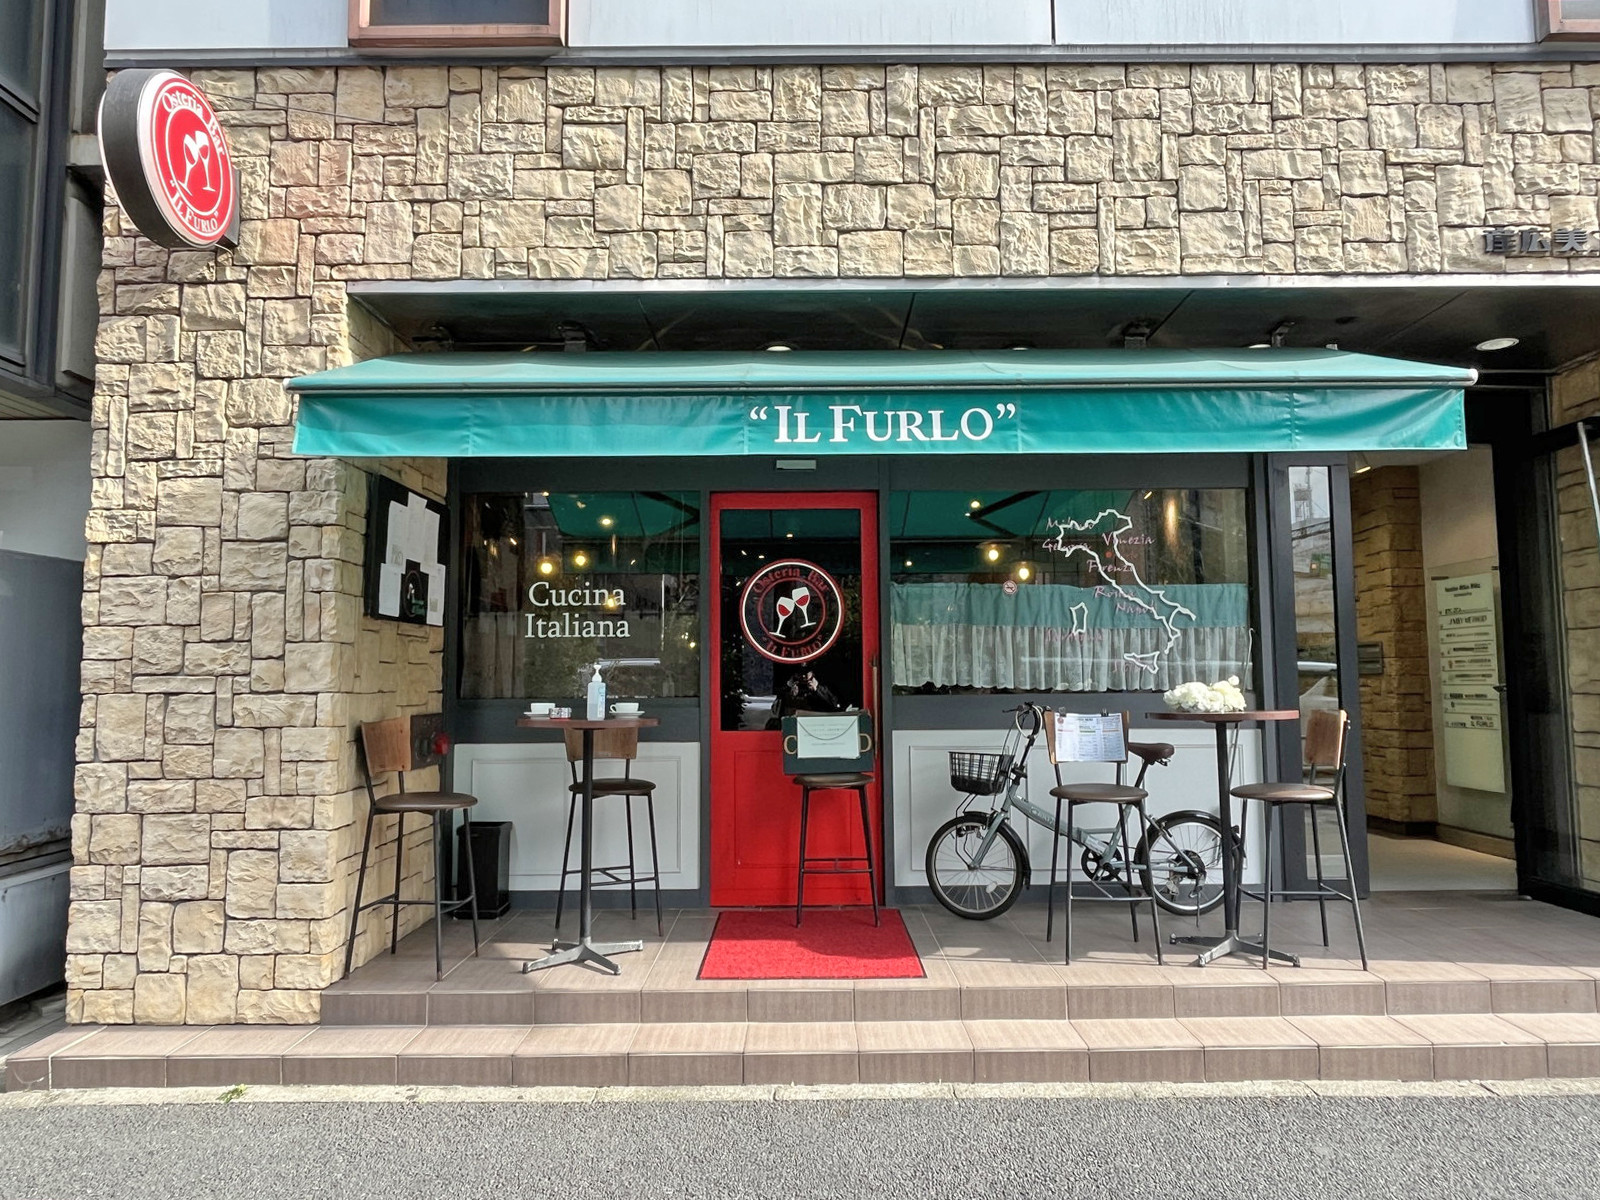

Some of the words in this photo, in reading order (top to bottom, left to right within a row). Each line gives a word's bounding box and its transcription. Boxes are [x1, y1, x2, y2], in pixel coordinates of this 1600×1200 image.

[161, 90, 204, 119] Osteria
[206, 113, 225, 156] Bar
[528, 581, 626, 607] Cucina
[524, 612, 631, 638] Italiana
